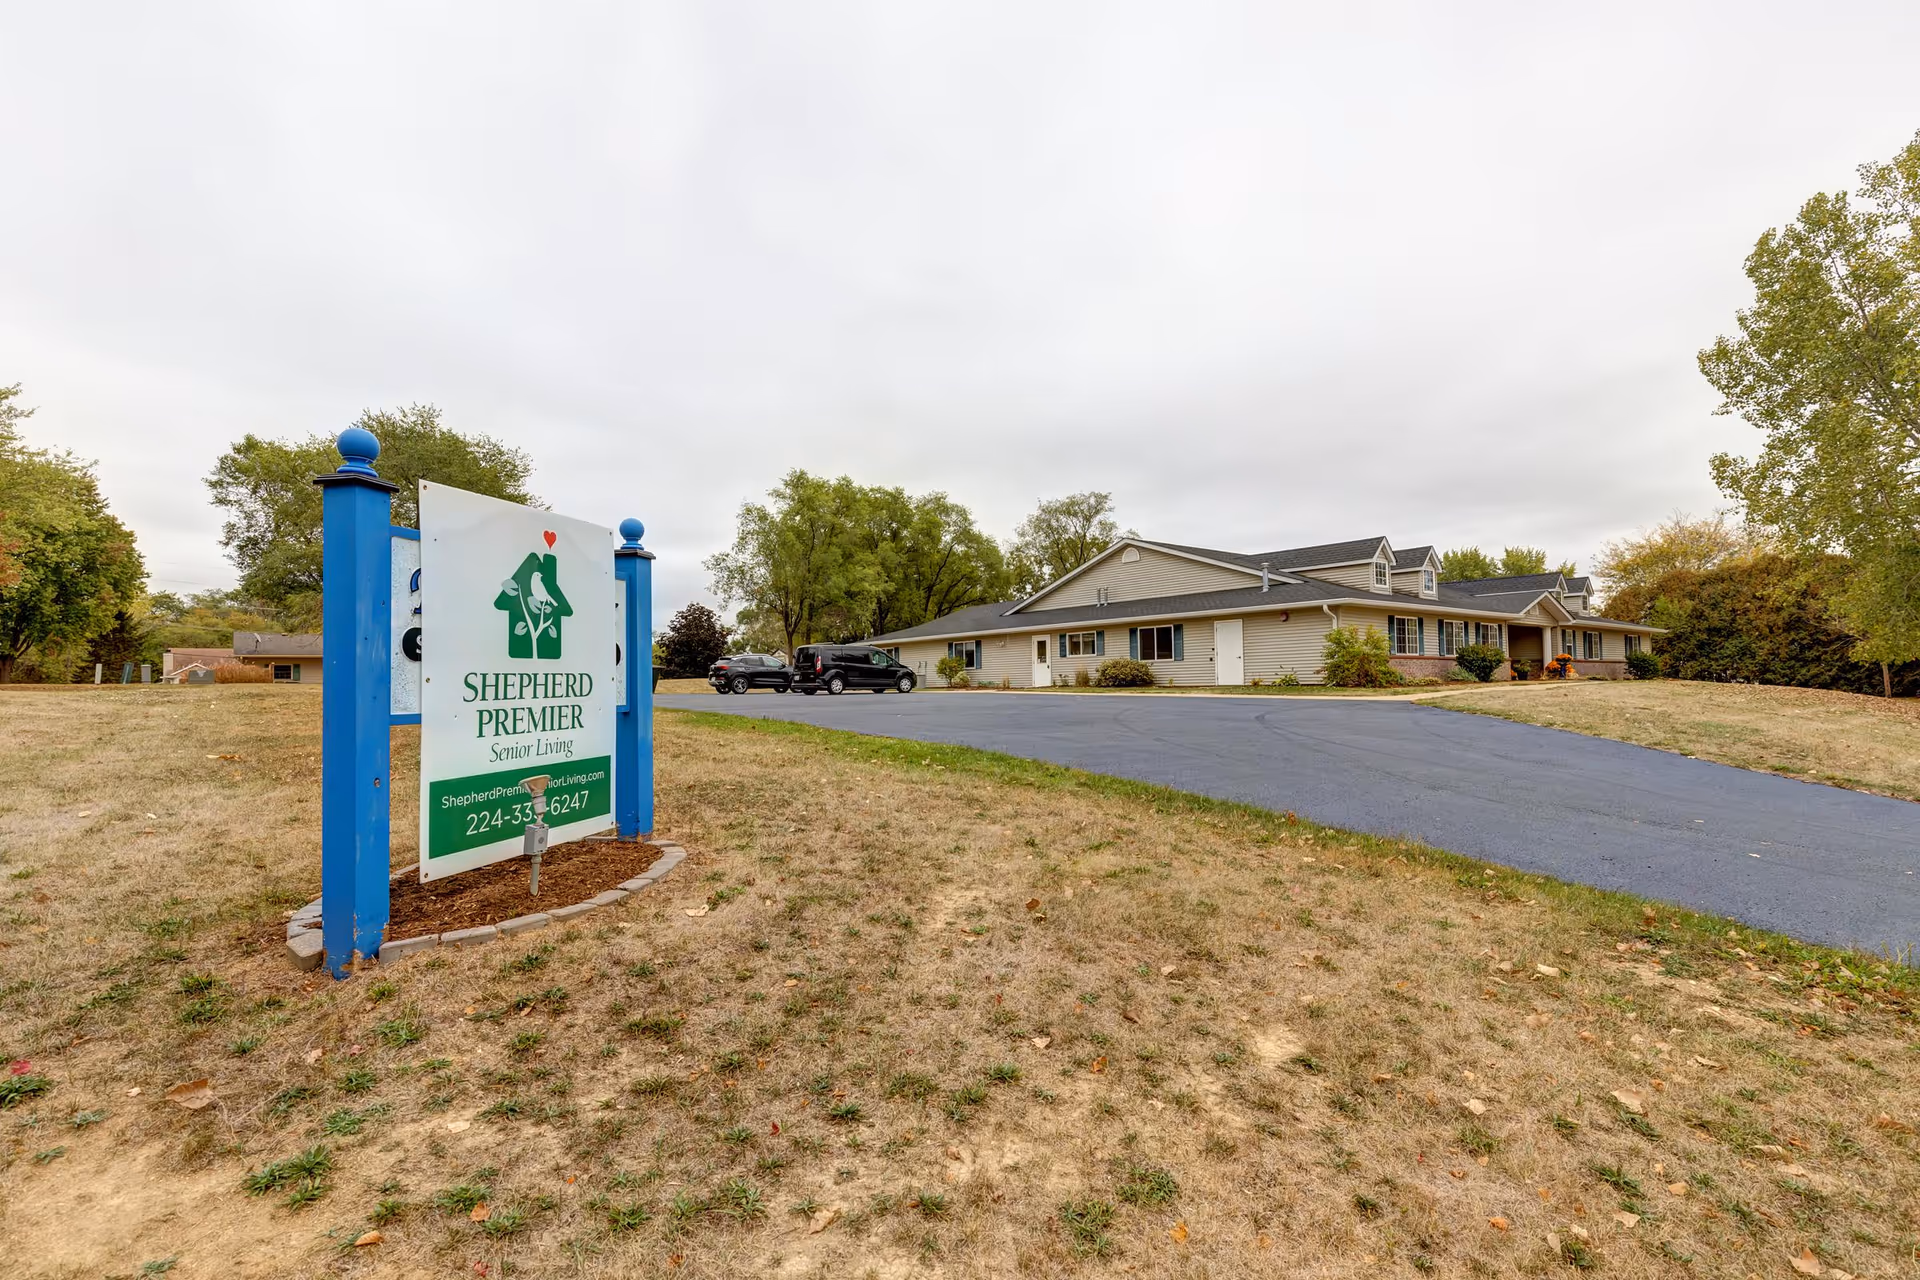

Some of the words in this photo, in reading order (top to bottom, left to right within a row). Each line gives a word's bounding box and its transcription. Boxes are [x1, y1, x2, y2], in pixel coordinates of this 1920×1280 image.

[462, 672, 593, 702] SHEPHERD
[476, 704, 584, 738] PREMIER
[489, 742, 533, 763] Senior
[536, 737, 574, 758] Living
[441, 770, 605, 809] ShepherdPreminiorLiving.com
[466, 790, 589, 836] 224-33-6247
